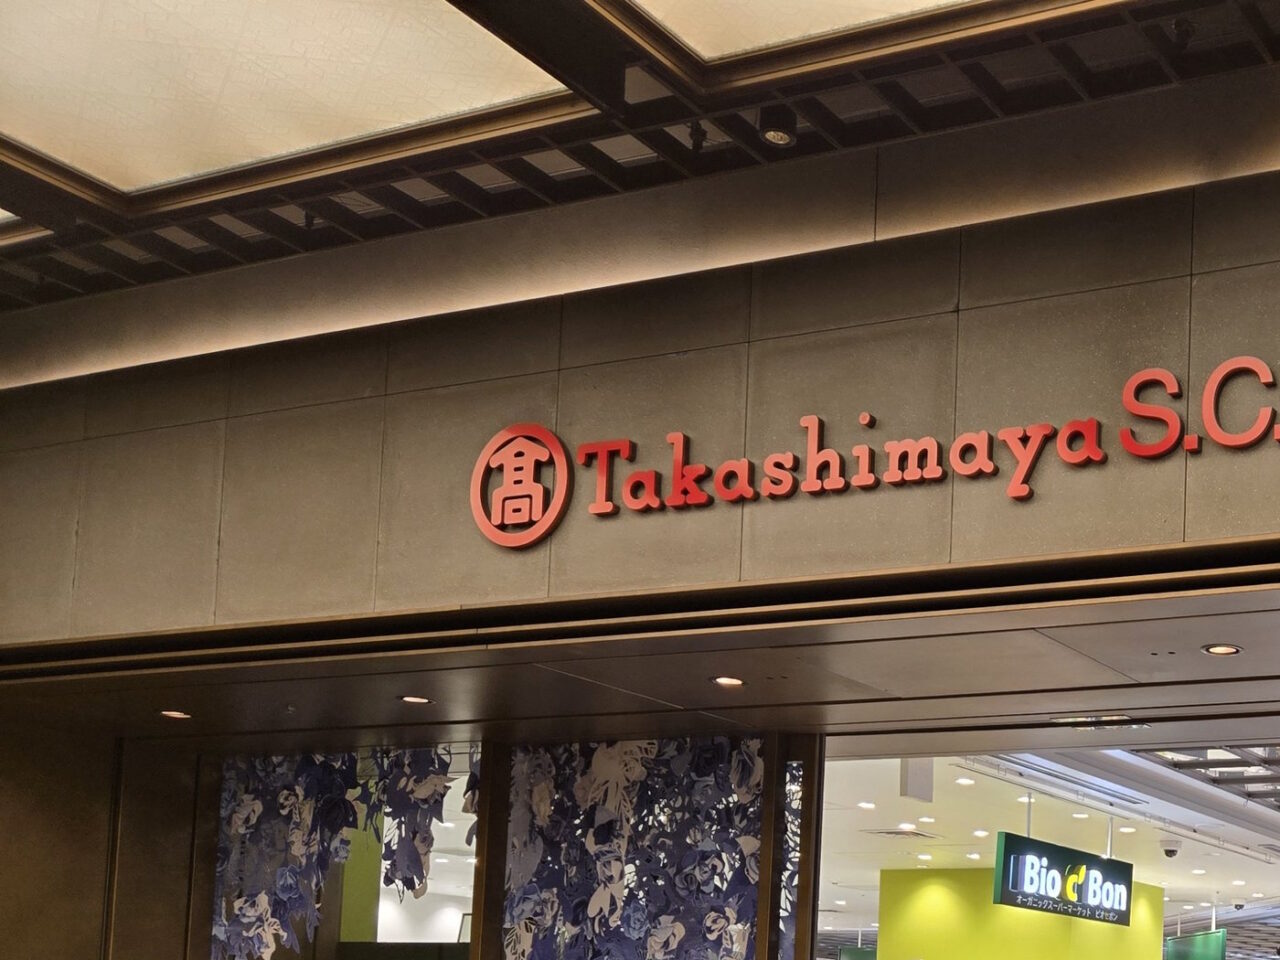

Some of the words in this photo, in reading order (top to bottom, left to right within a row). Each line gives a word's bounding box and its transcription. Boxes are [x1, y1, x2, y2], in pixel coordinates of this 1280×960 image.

[577, 411, 1107, 517] Takashimaya
[1023, 854, 1062, 900] Bio
[1087, 869, 1128, 911] Bon
